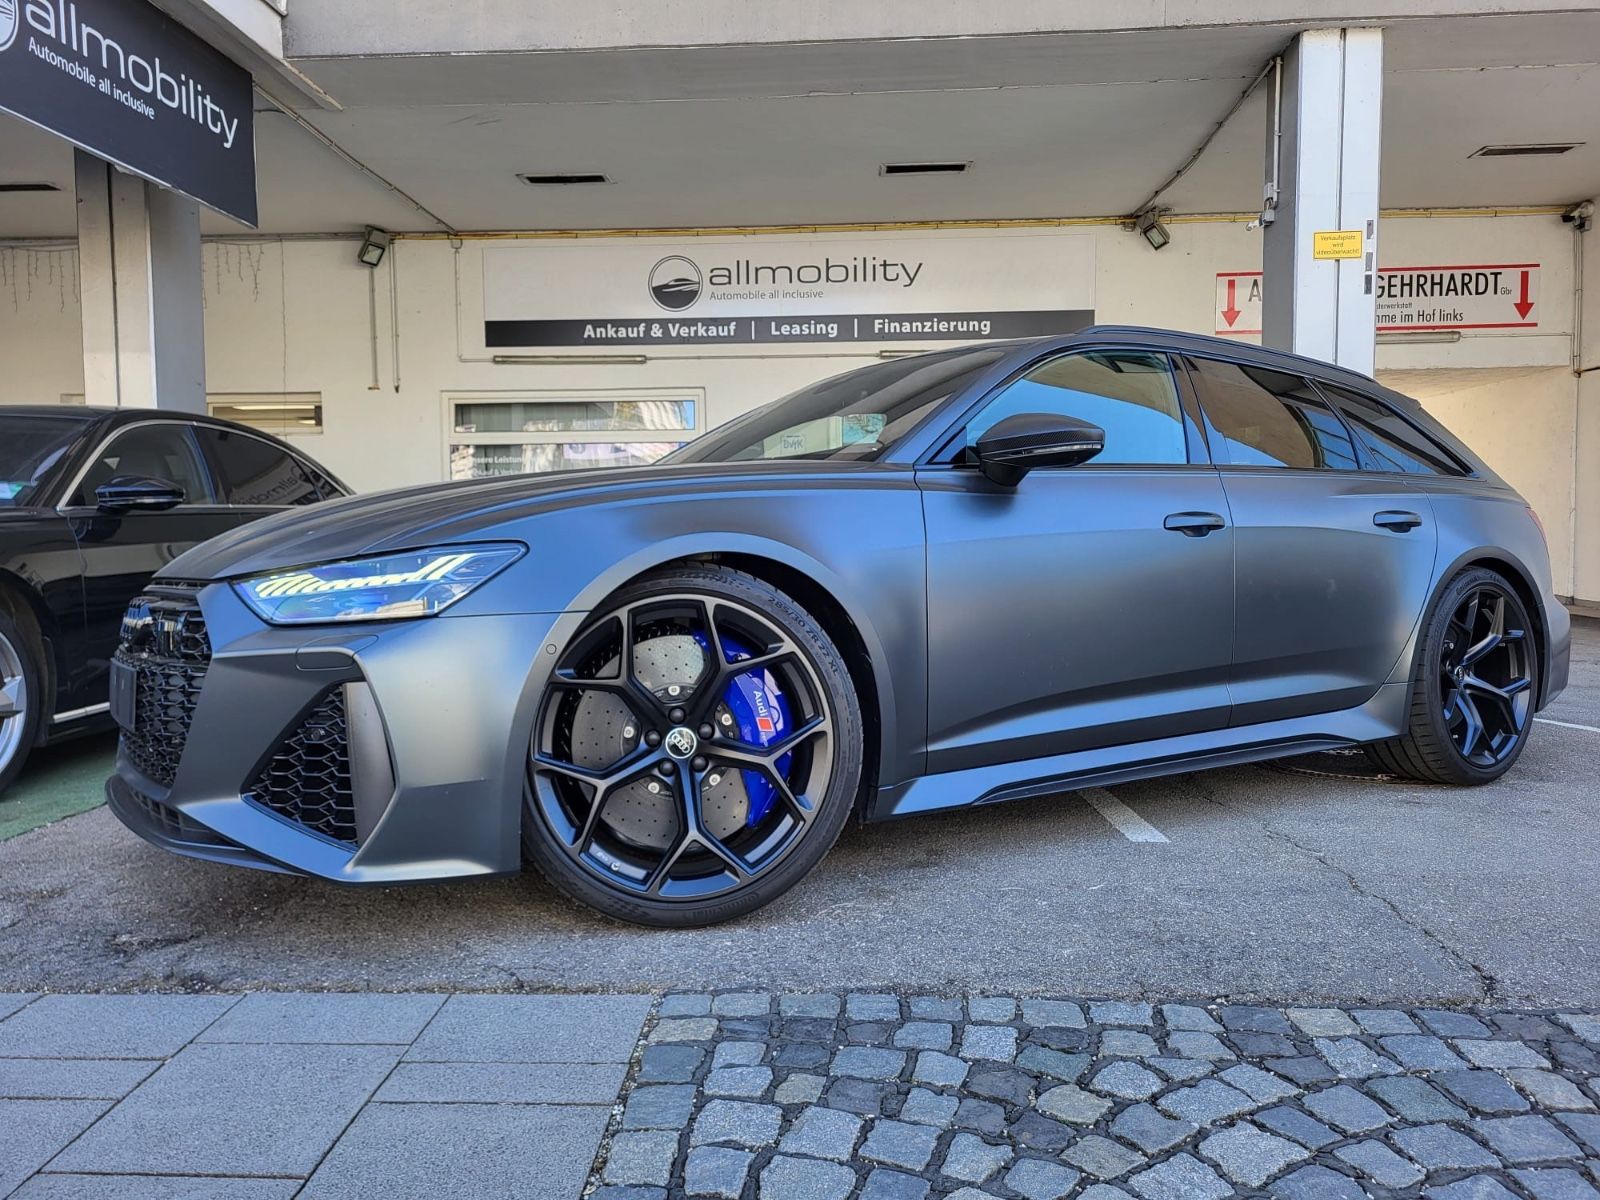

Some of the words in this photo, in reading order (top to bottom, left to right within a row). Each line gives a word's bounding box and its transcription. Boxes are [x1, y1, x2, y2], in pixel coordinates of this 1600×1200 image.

[26, 0, 238, 148] allmobility
[28, 36, 96, 88] Automobile
[98, 78, 111, 95] all
[113, 84, 155, 120] inclusive
[709, 256, 923, 287] allmobility
[709, 291, 766, 301] Automobile
[768, 289, 780, 300] all
[782, 288, 824, 299] inclusive
[1248, 278, 1262, 302] A
[1500, 286, 1513, 296] Gbr
[583, 321, 646, 339] Ankauf
[650, 322, 664, 338] &
[667, 320, 737, 338] Verkauf
[770, 319, 838, 338] Leasing
[874, 317, 991, 335] Finanzierung
[1400, 311, 1414, 323] im
[1417, 309, 1436, 323] Hof
[1439, 307, 1464, 322] links
[805, 628, 820, 643] ZR
[818, 645, 830, 658] 22
[753, 690, 768, 717] Audi
